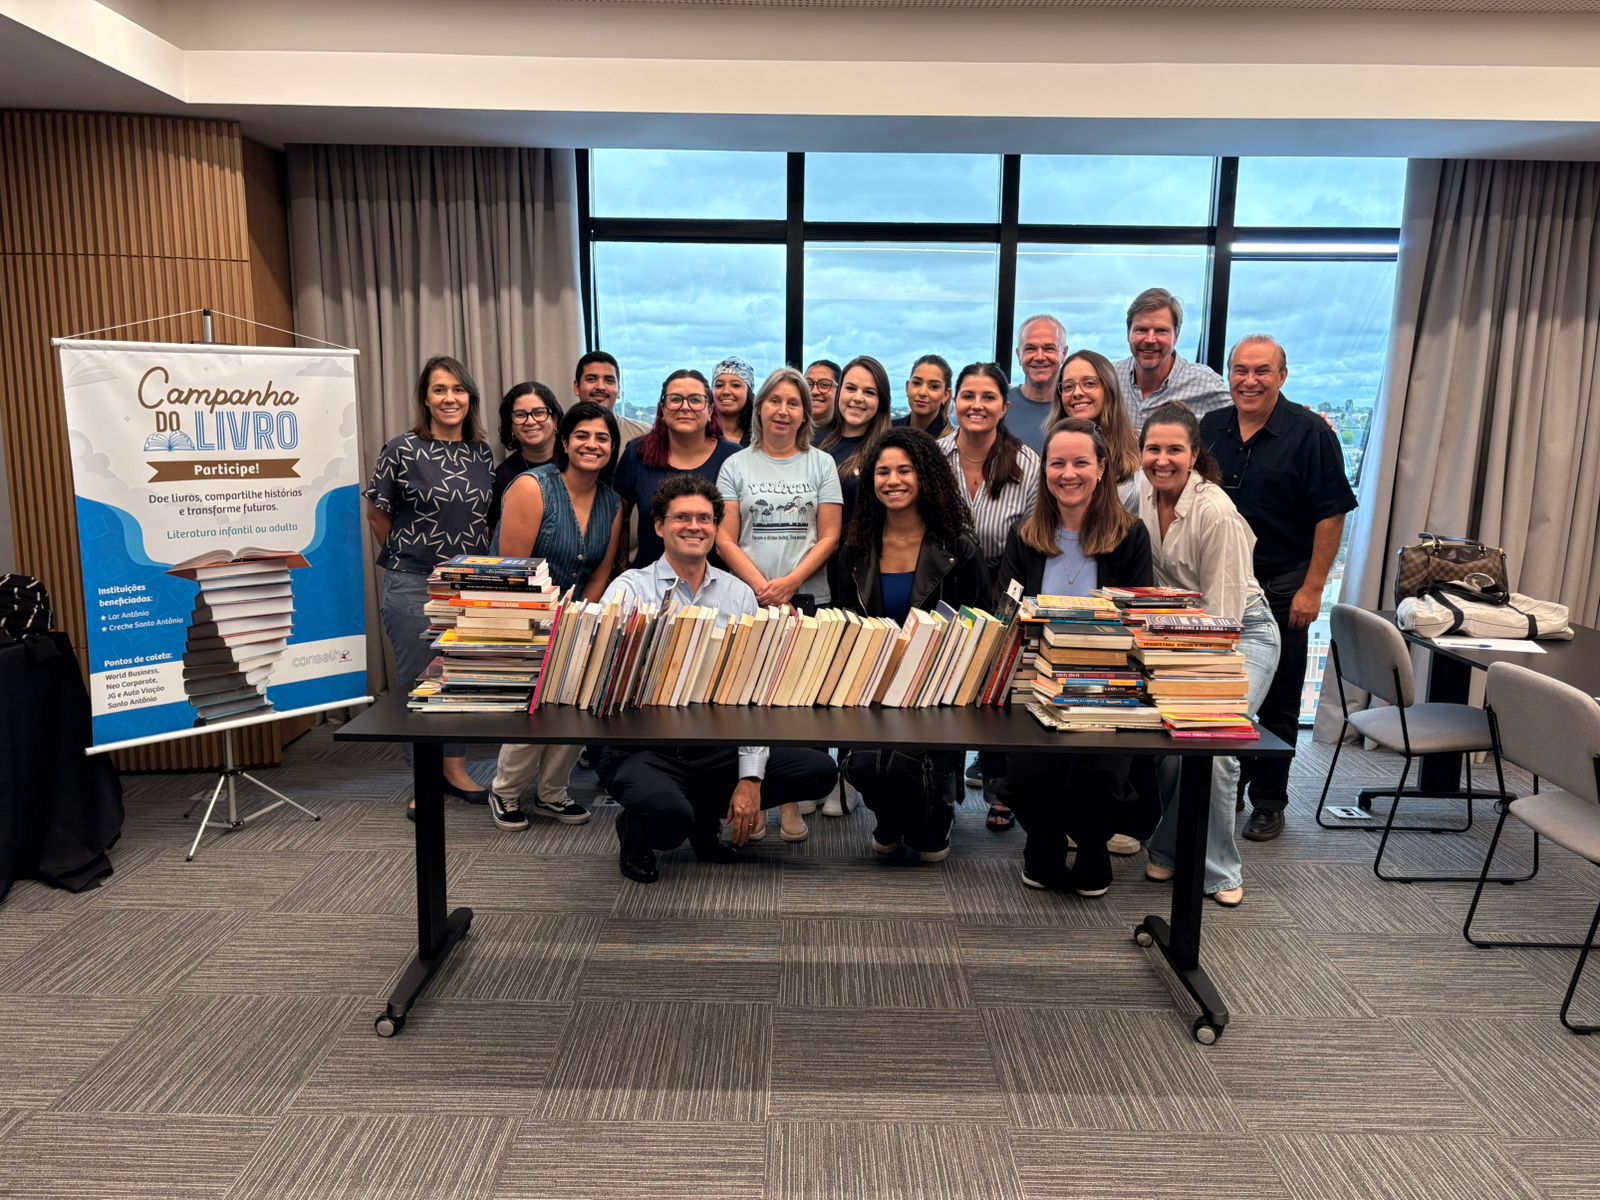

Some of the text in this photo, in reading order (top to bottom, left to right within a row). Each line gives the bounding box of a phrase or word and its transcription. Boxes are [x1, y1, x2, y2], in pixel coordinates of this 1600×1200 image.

[137, 366, 299, 414] Campanha
[156, 410, 299, 450] DO LIVRO
[194, 462, 260, 478] Participe!
[148, 487, 303, 504] Doe livros, compartilhe histórias
[179, 502, 279, 516] e transforme futuros.
[167, 528, 217, 540] Literatura
[219, 525, 253, 538] infantil
[269, 522, 298, 533] adulta
[98, 584, 146, 595] Instituições
[99, 596, 153, 607] beneficiadas:
[121, 609, 150, 619] Antônio
[109, 616, 184, 632] Creche Santo Antônio
[104, 652, 173, 667] Pontos de coleta:
[105, 667, 160, 681] World Business,
[106, 677, 158, 690] Neo Corporate,
[107, 692, 116, 700] JG
[123, 689, 140, 697] Auto
[141, 685, 165, 695] Viação
[107, 695, 157, 709] Santo Antônio
